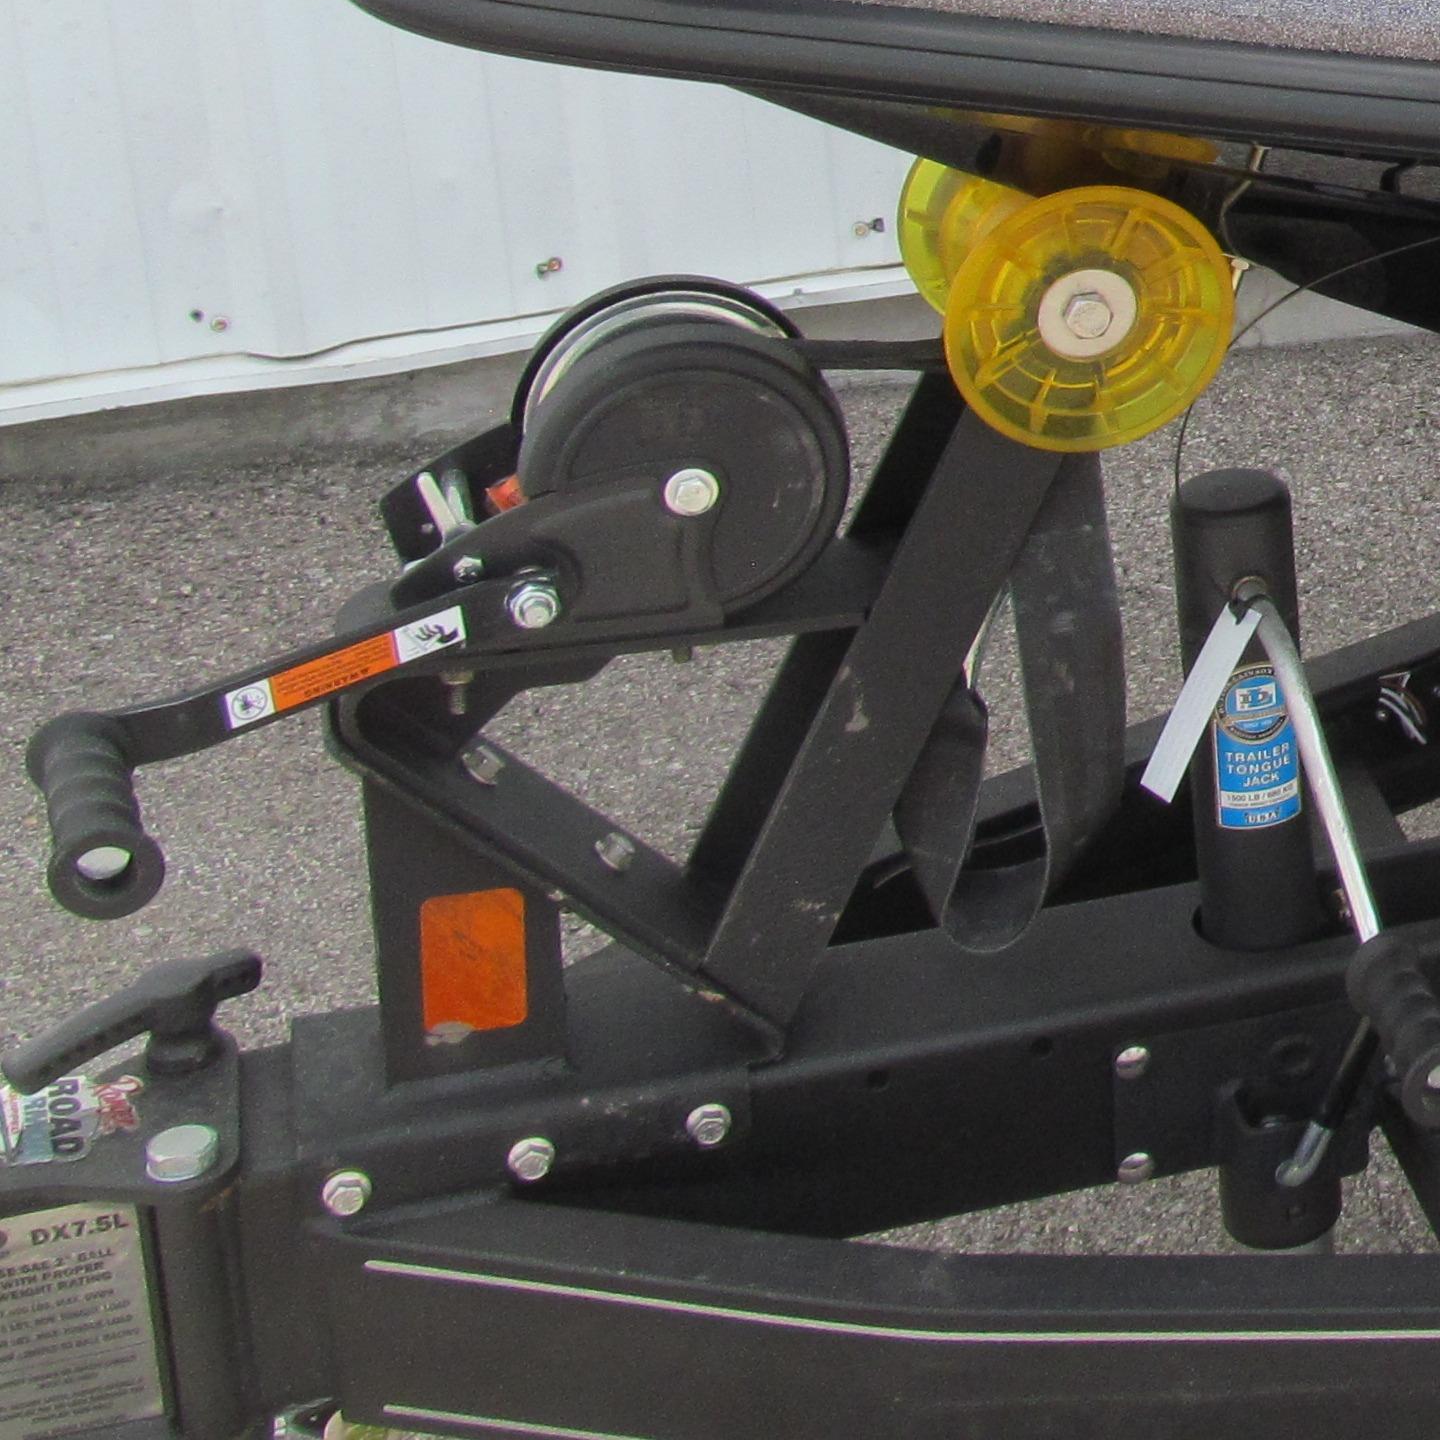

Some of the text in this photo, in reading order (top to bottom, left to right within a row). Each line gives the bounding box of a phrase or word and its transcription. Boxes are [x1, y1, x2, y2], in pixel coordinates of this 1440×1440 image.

[1225, 742, 1290, 763] TRAILER
[1226, 753, 1291, 776] TONGUE
[1243, 771, 1280, 788] JACK
[48, 1078, 84, 1154] ROAD
[30, 1213, 129, 1246] DX7.5L
